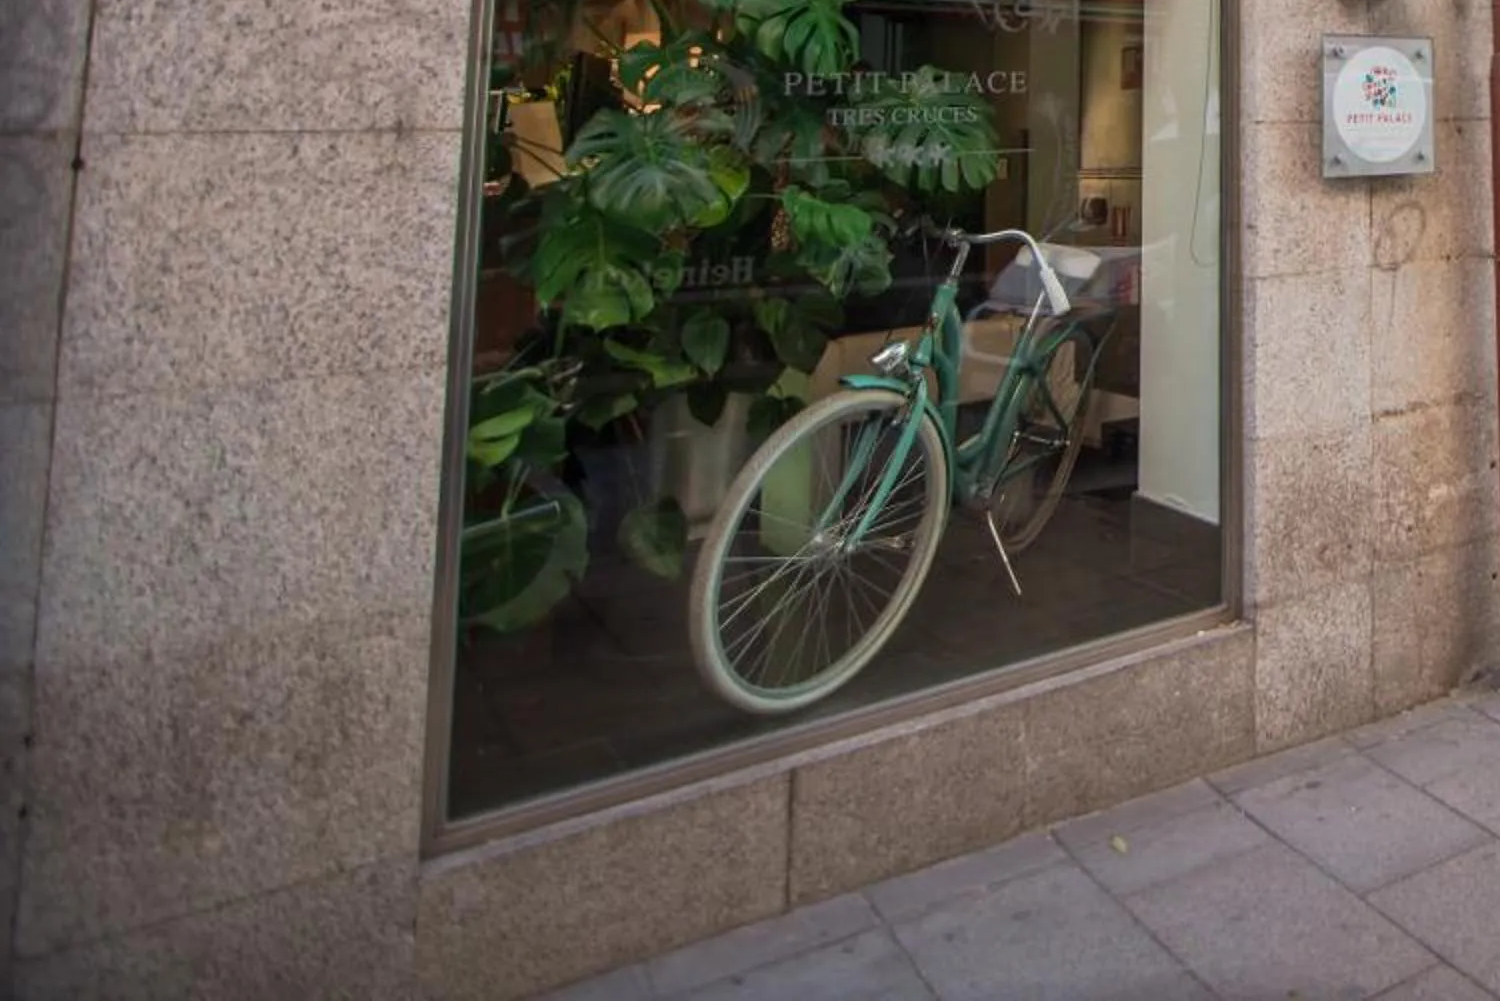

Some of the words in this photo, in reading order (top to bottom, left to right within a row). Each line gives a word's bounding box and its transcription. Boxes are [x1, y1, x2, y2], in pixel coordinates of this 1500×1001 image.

[783, 71, 888, 97] PETIT
[826, 107, 886, 127] TRES
[890, 106, 979, 126] CRUCES
[1346, 112, 1374, 124] PETIT
